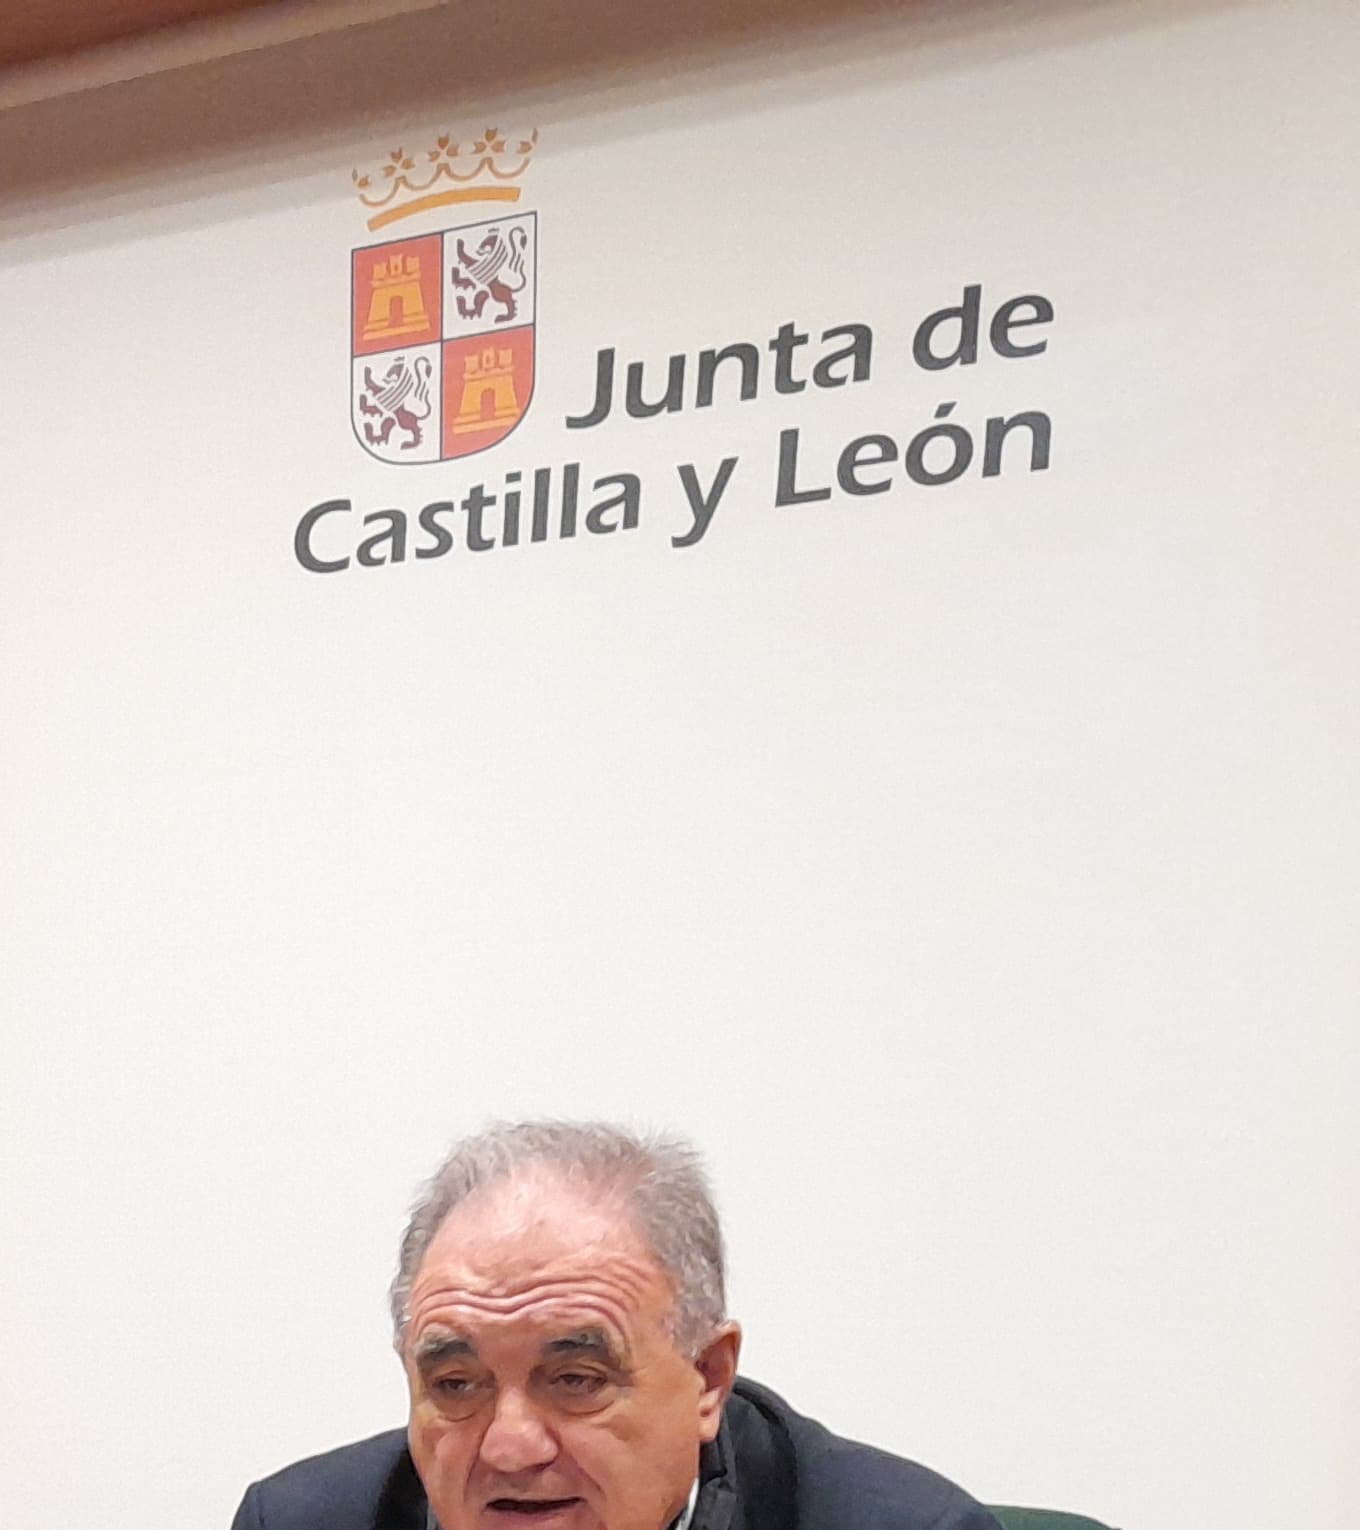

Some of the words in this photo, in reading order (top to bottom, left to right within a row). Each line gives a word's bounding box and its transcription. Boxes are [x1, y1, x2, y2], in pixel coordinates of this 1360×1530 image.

[564, 321, 875, 430] Junta
[910, 283, 1056, 372] de
[292, 461, 642, 575] Castilla
[670, 456, 739, 549] y
[774, 401, 1053, 508] León
